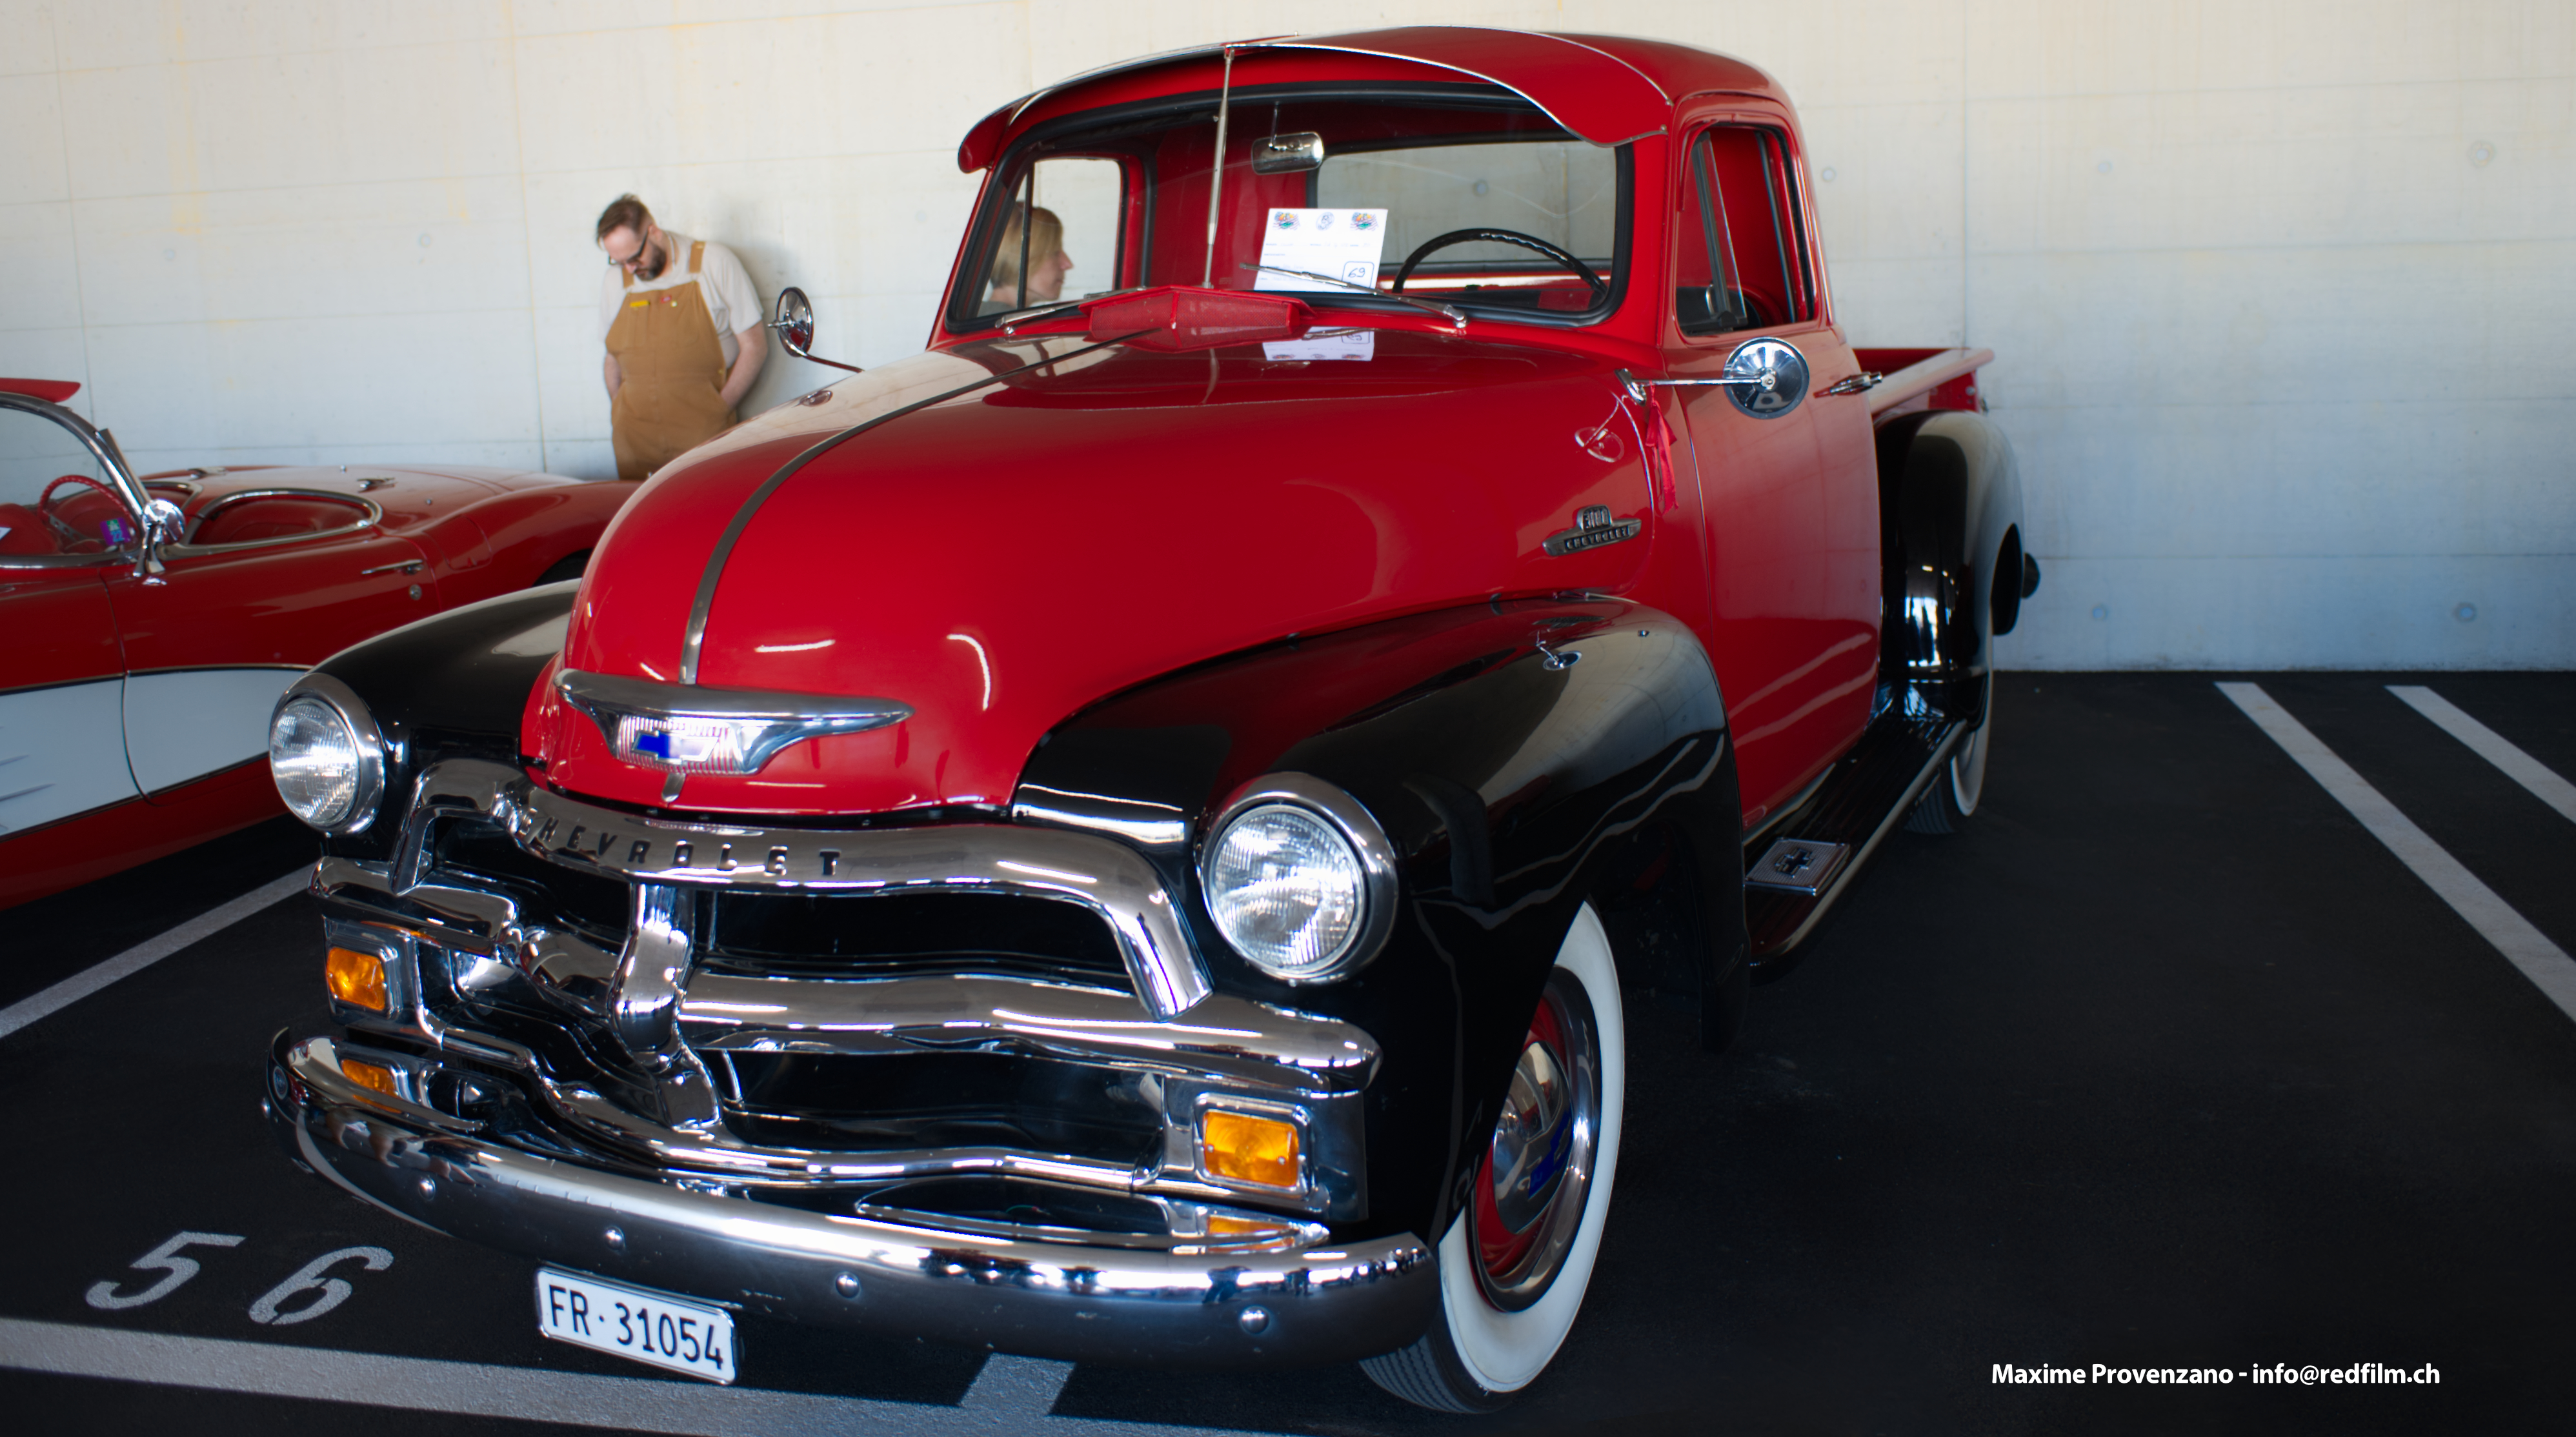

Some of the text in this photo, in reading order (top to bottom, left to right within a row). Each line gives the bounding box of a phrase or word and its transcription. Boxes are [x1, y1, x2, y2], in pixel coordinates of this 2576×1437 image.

[1347, 267, 1365, 278] 69
[1566, 526, 1627, 549] CHEVROLET
[519, 807, 841, 876] CHEVROLET
